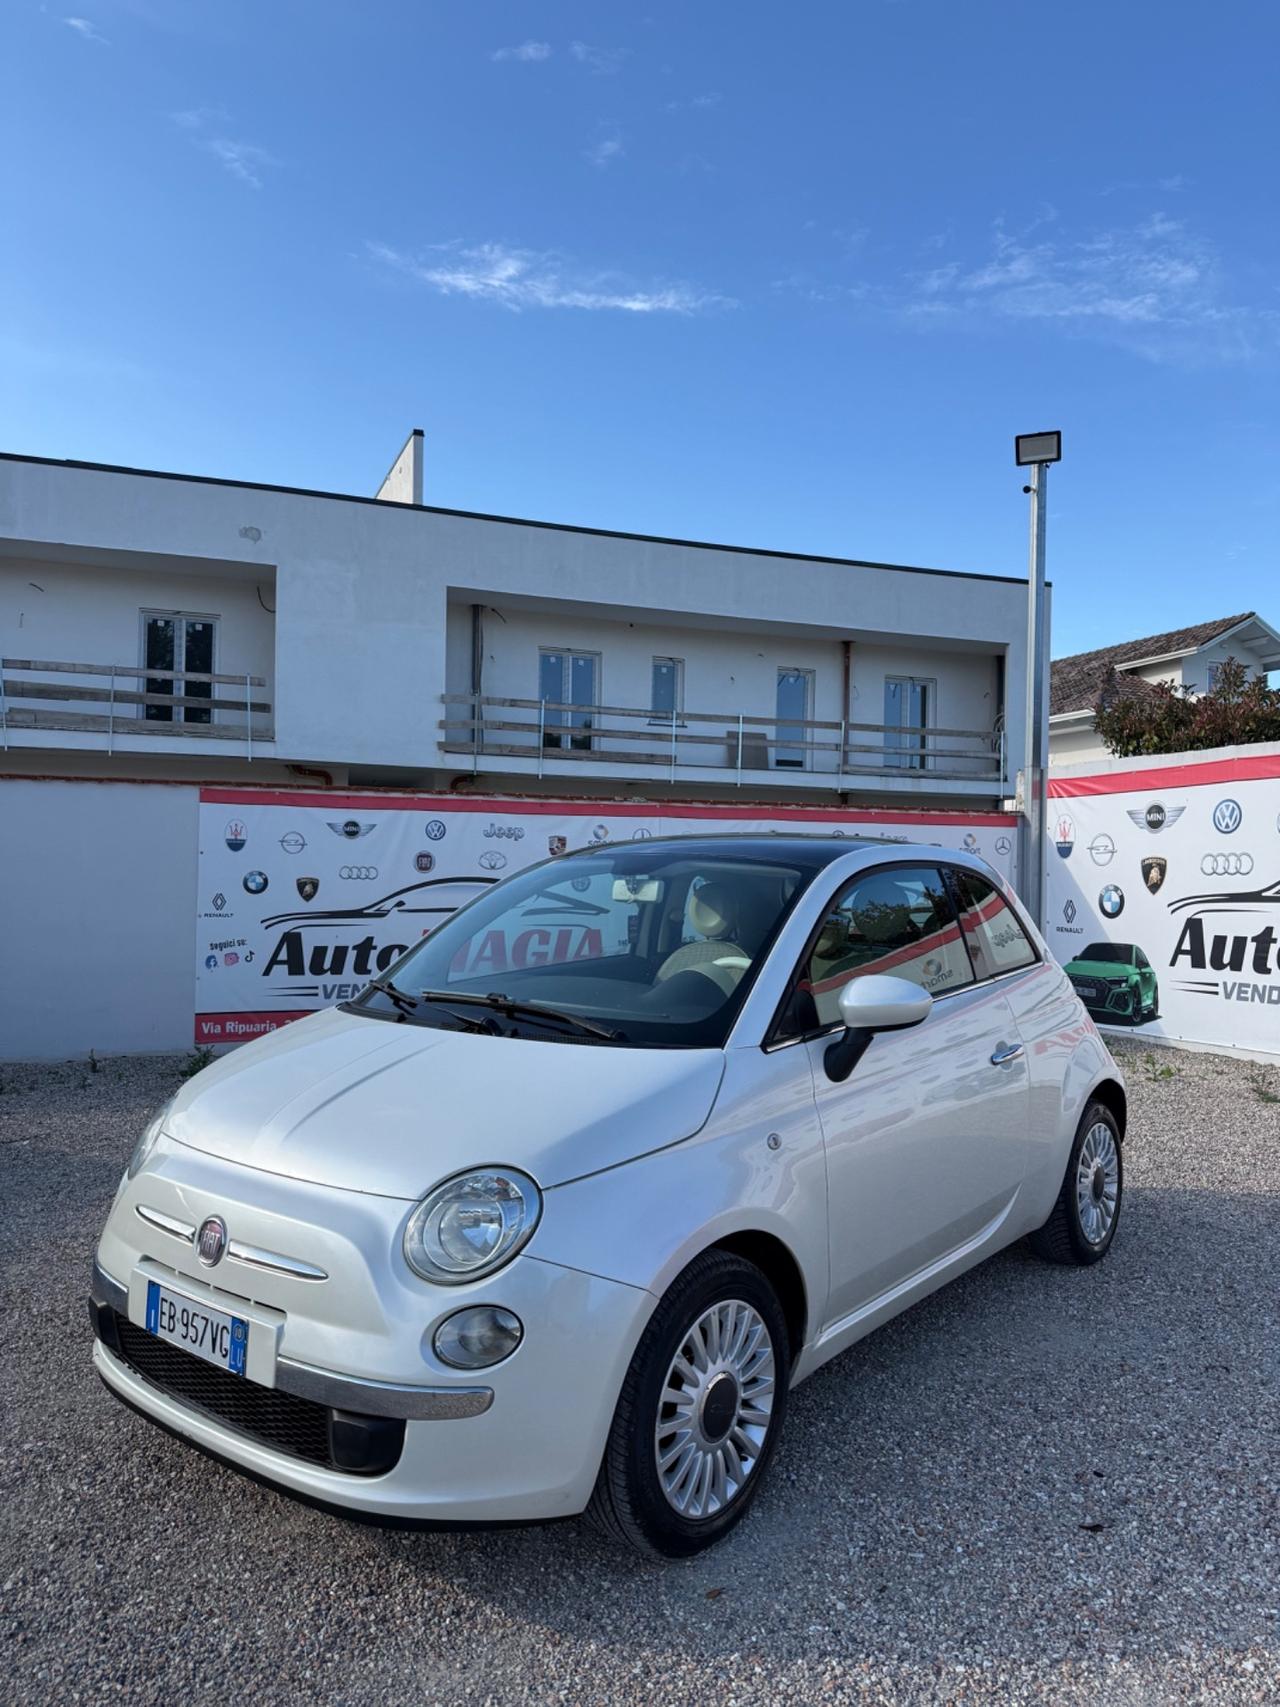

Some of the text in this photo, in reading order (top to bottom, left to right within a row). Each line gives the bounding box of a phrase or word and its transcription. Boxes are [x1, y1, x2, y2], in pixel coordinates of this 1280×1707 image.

[1146, 813, 1165, 822] MINI
[482, 823, 525, 841] Jeep
[1056, 926, 1084, 935] RENAULT
[1169, 917, 1280, 975] Aut
[201, 1022, 221, 1034] Via
